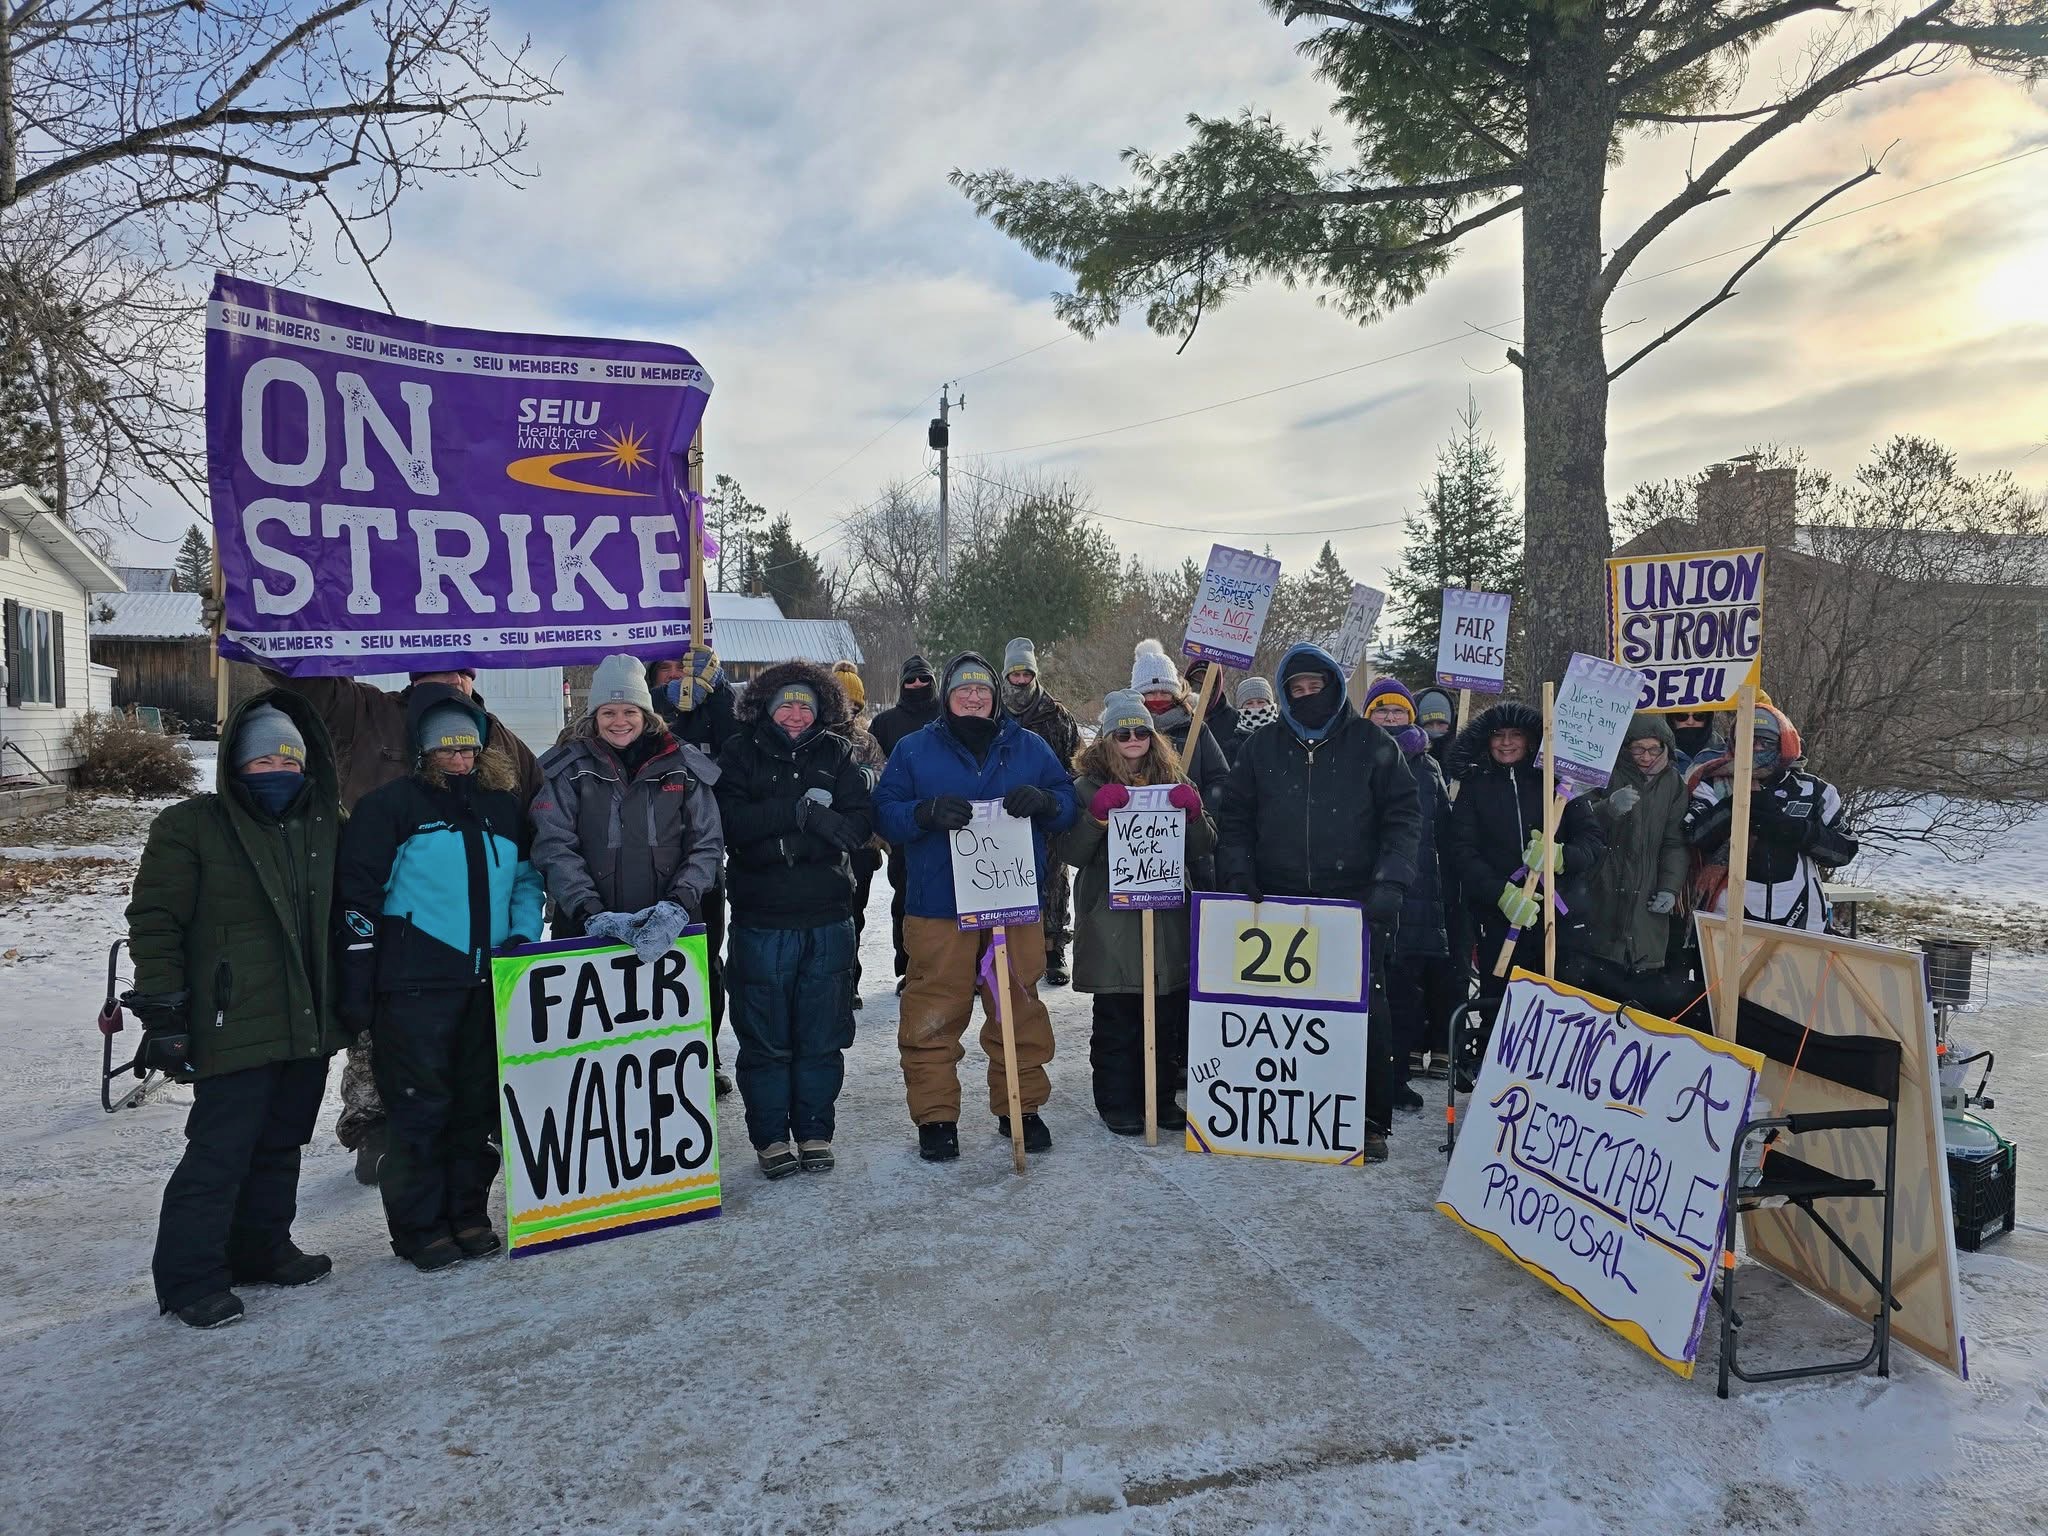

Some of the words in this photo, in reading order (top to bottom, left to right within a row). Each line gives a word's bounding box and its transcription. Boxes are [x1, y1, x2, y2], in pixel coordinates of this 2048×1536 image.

[222, 308, 249, 327] SEIU
[256, 315, 320, 342] MEMBERS
[346, 335, 375, 352] SEIU
[380, 341, 444, 365] MEMBERS
[473, 356, 503, 370] SEIU
[509, 359, 578, 374] MEMBERS
[606, 365, 635, 378] SEIU
[641, 368, 702, 382] MEMBERS
[518, 398, 601, 424] SEIU
[241, 357, 439, 495] ON
[518, 424, 597, 439] Healthcare
[518, 438, 544, 449] MN
[549, 438, 560, 450] &
[565, 439, 580, 450] IA
[243, 498, 691, 615] STRIKE
[1214, 550, 1276, 578] SEIU
[1216, 586, 1252, 600] ADMIN
[1625, 552, 1764, 611] UNION
[1452, 590, 1507, 609] SEIU
[1224, 608, 1255, 627] NOT
[1455, 616, 1495, 642] FAIR
[270, 636, 333, 651] MEMBERS
[361, 635, 393, 649] SEIU
[400, 633, 472, 648] MEMBERS
[500, 632, 529, 645] SEIU
[534, 630, 602, 644] MEMBERS
[628, 626, 657, 640] SEIU
[1622, 607, 1760, 664] STRONG
[1454, 643, 1503, 667] WAGES
[1578, 658, 1645, 690] SEIU
[1636, 667, 1726, 710] SEIU
[1558, 703, 1594, 724] Silent
[1598, 717, 1616, 735] any
[1611, 701, 1631, 715] not
[280, 743, 291, 753] On
[441, 736, 453, 746] On
[1560, 730, 1583, 745] Fair
[1114, 814, 1142, 840] We
[1146, 816, 1179, 839] don't
[955, 828, 999, 856] On
[972, 857, 1037, 890] Strike
[1113, 857, 1130, 876] for
[1239, 927, 1311, 983] 26
[529, 950, 690, 1043] FAIR
[1221, 1011, 1330, 1055] DAYS
[1191, 1057, 1221, 1083] ULP
[1255, 1057, 1297, 1082] ON
[1496, 984, 1617, 1101] WAITING
[1610, 1040, 1671, 1107] ON
[1667, 1065, 1730, 1152] A
[503, 1040, 713, 1200] WAGES
[1208, 1079, 1357, 1152] STRIKE
[1490, 1086, 1719, 1251] RESPECTABLE
[1481, 1163, 1639, 1295] PROPOSAL
